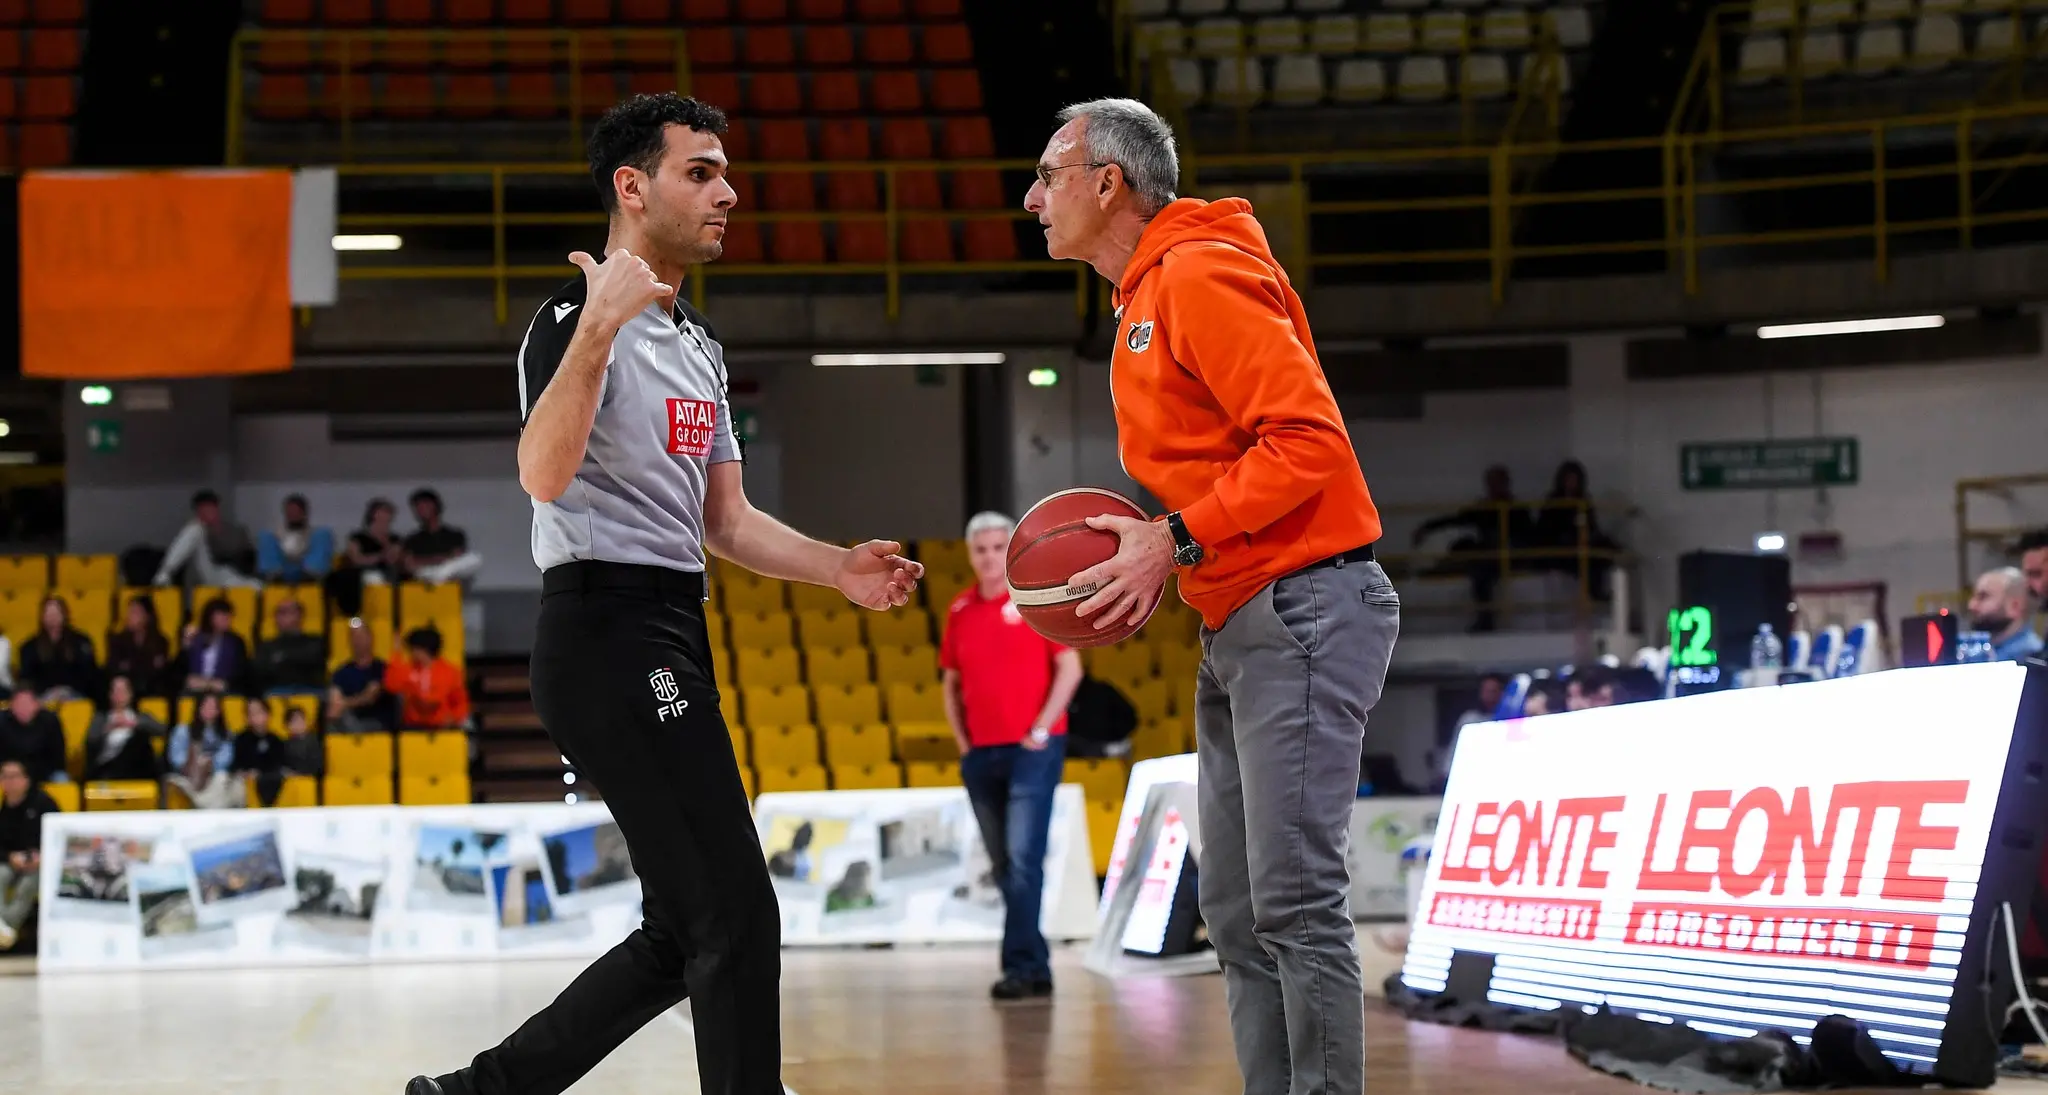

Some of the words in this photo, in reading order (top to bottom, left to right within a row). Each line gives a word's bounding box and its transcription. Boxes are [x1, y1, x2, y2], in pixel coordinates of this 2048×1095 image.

[675, 400, 713, 428] ATTAL
[676, 427, 713, 444] GROUP
[657, 699, 689, 722] FIP
[1438, 795, 1627, 887] LEONTE
[1636, 780, 1970, 903] LEONTE
[1635, 909, 1915, 963] ARREDAMENTI
